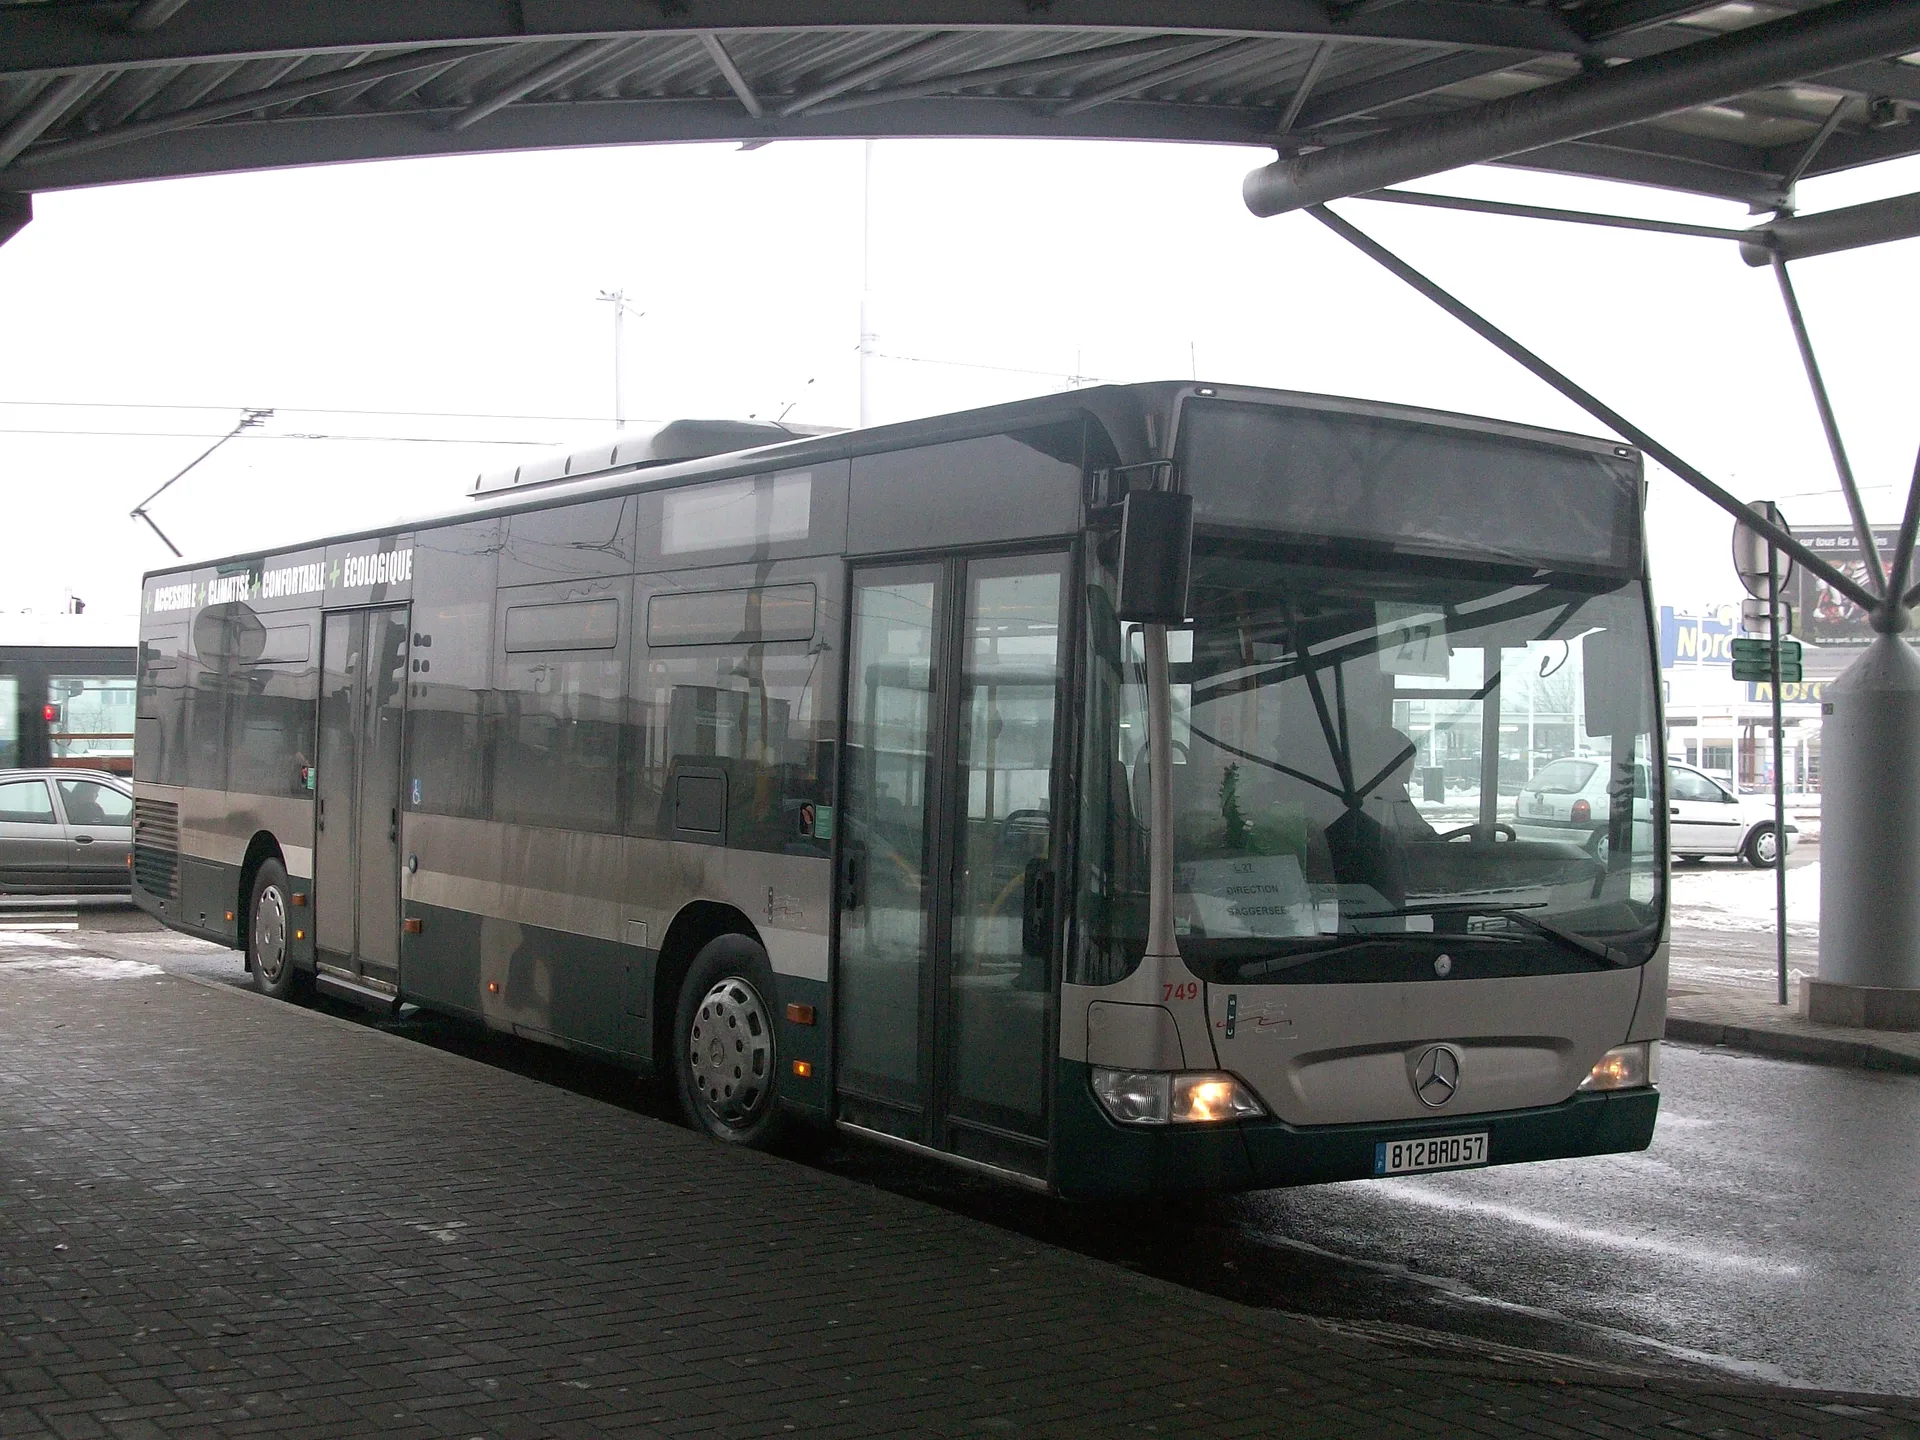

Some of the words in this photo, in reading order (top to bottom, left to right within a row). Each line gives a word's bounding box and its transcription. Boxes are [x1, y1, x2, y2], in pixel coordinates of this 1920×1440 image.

[153, 583, 197, 612] ACCESSIBLE
[207, 569, 250, 605] CLIMATISÉ
[262, 562, 326, 599] CONFORTABLE
[343, 549, 413, 588] ÉCOLOGIQUE
[1395, 623, 1431, 661] 27
[1226, 884, 1280, 895] DIRECTION
[1163, 982, 1198, 1001] 749
